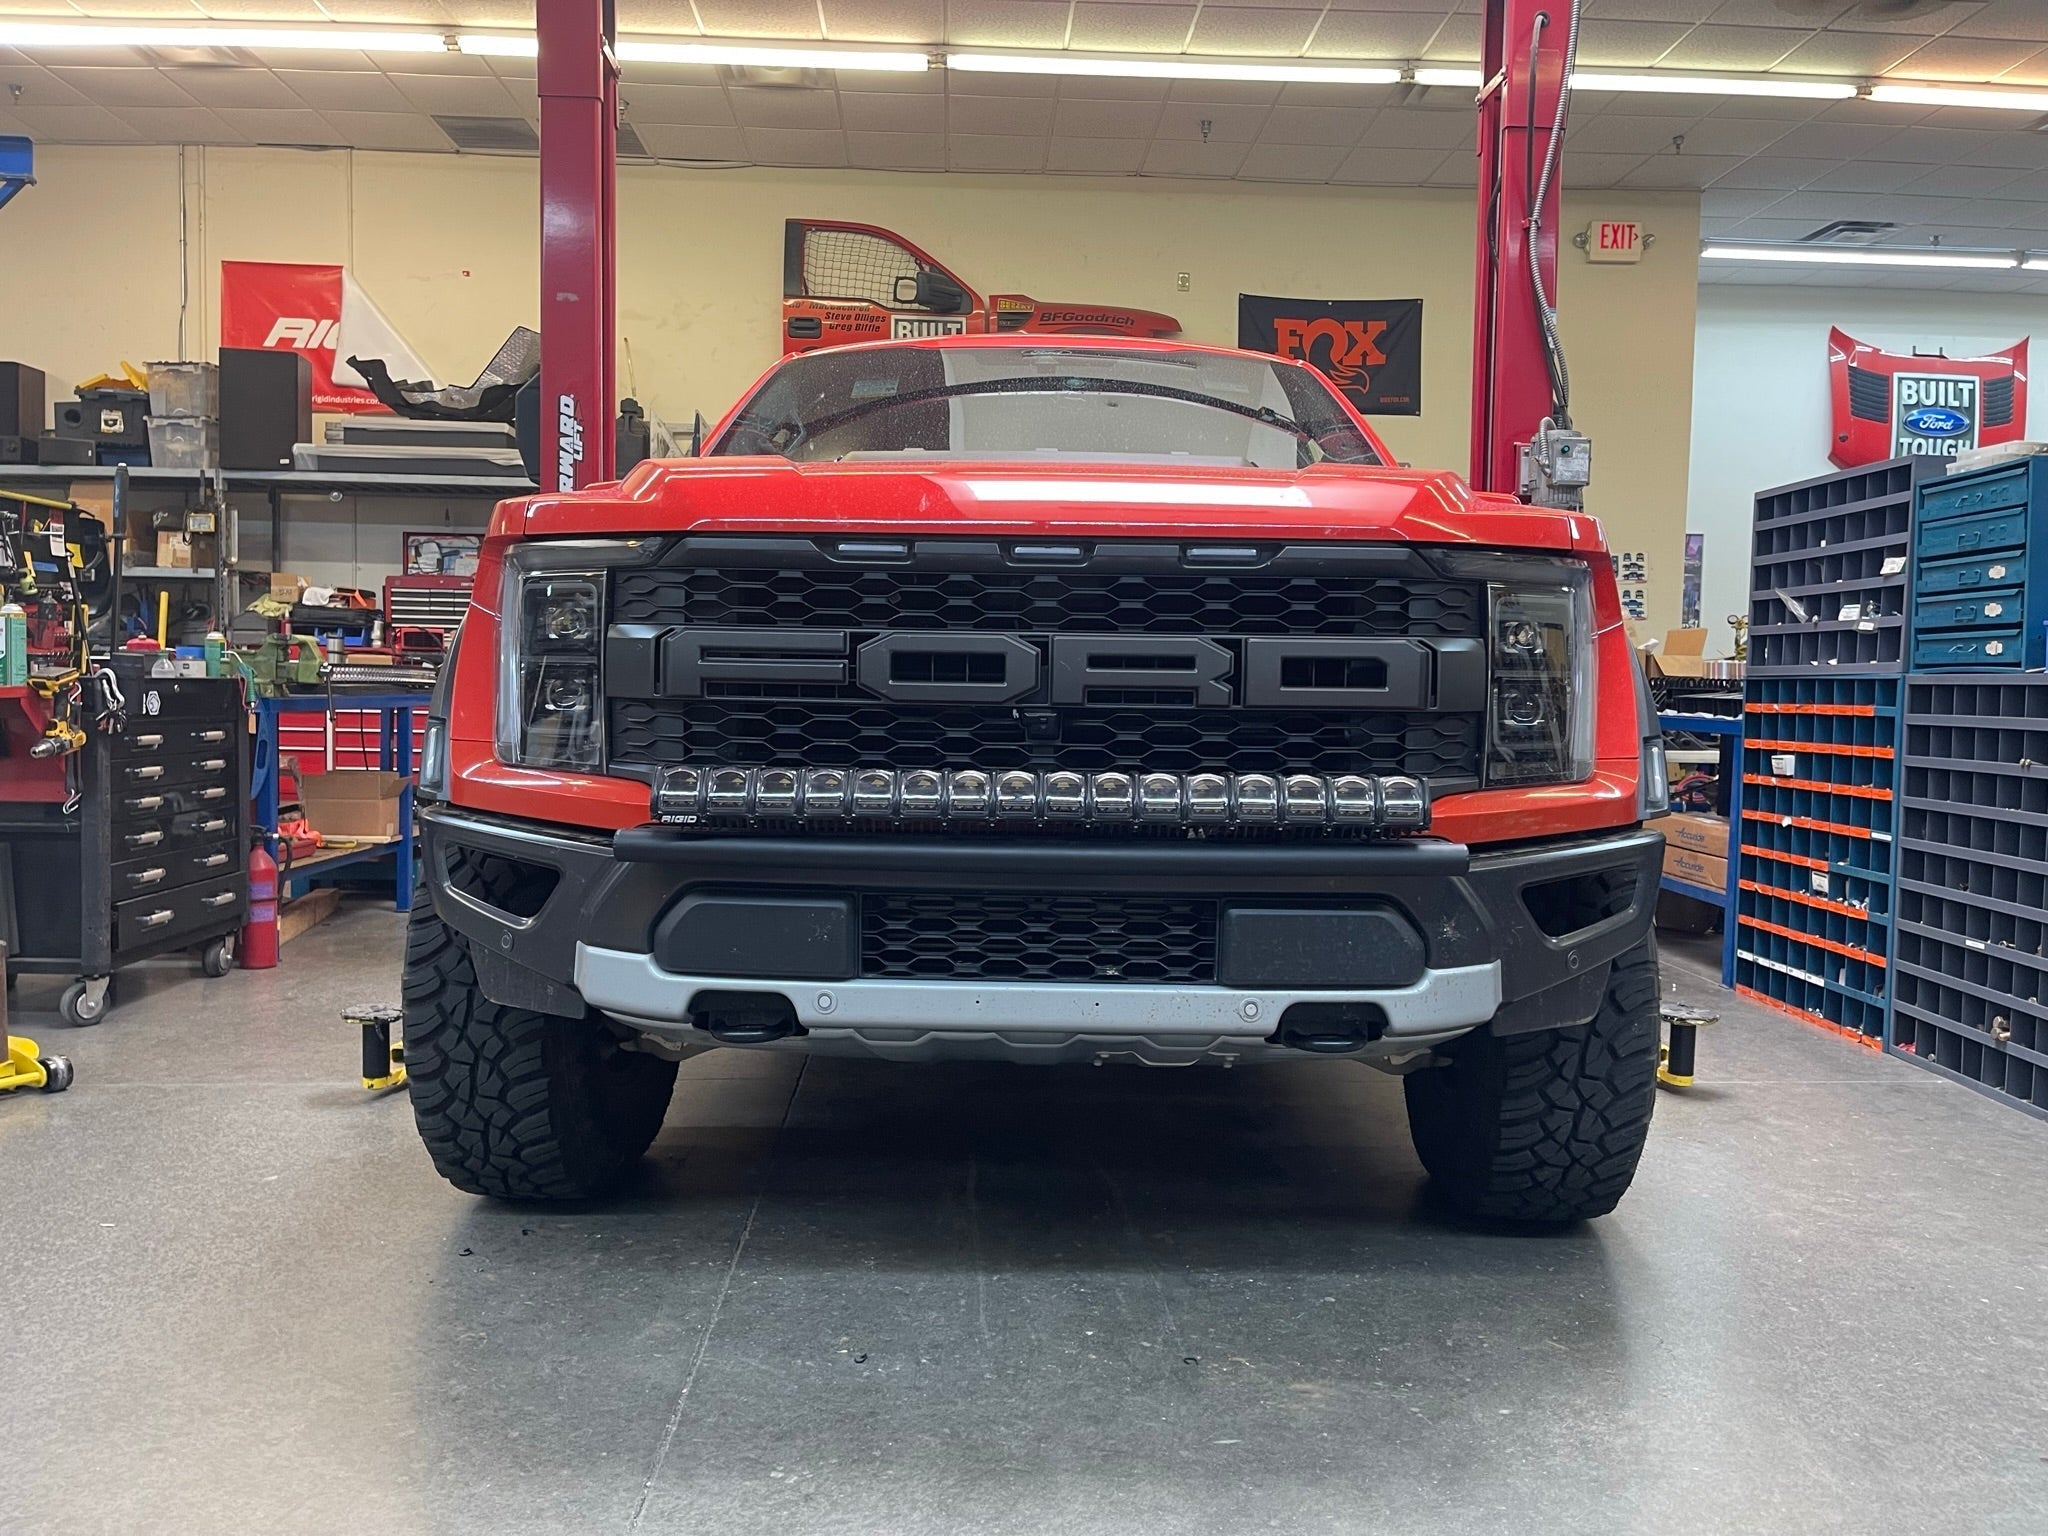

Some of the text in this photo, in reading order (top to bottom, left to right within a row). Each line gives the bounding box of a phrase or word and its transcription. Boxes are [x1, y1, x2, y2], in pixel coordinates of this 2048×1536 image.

[1600, 223, 1636, 249] EXIT
[825, 311, 887, 323] Steve Olliges
[1039, 312, 1136, 326] BFGoodrich
[829, 323, 881, 332] Greg Biffle
[897, 321, 961, 338] BUILT
[1273, 317, 1387, 367] FOX
[1901, 379, 1974, 407] BUILT
[1919, 413, 1955, 430] Ford
[573, 419, 584, 461] LIFT
[660, 627, 1430, 708] FORD
[661, 815, 698, 823] RIGID
